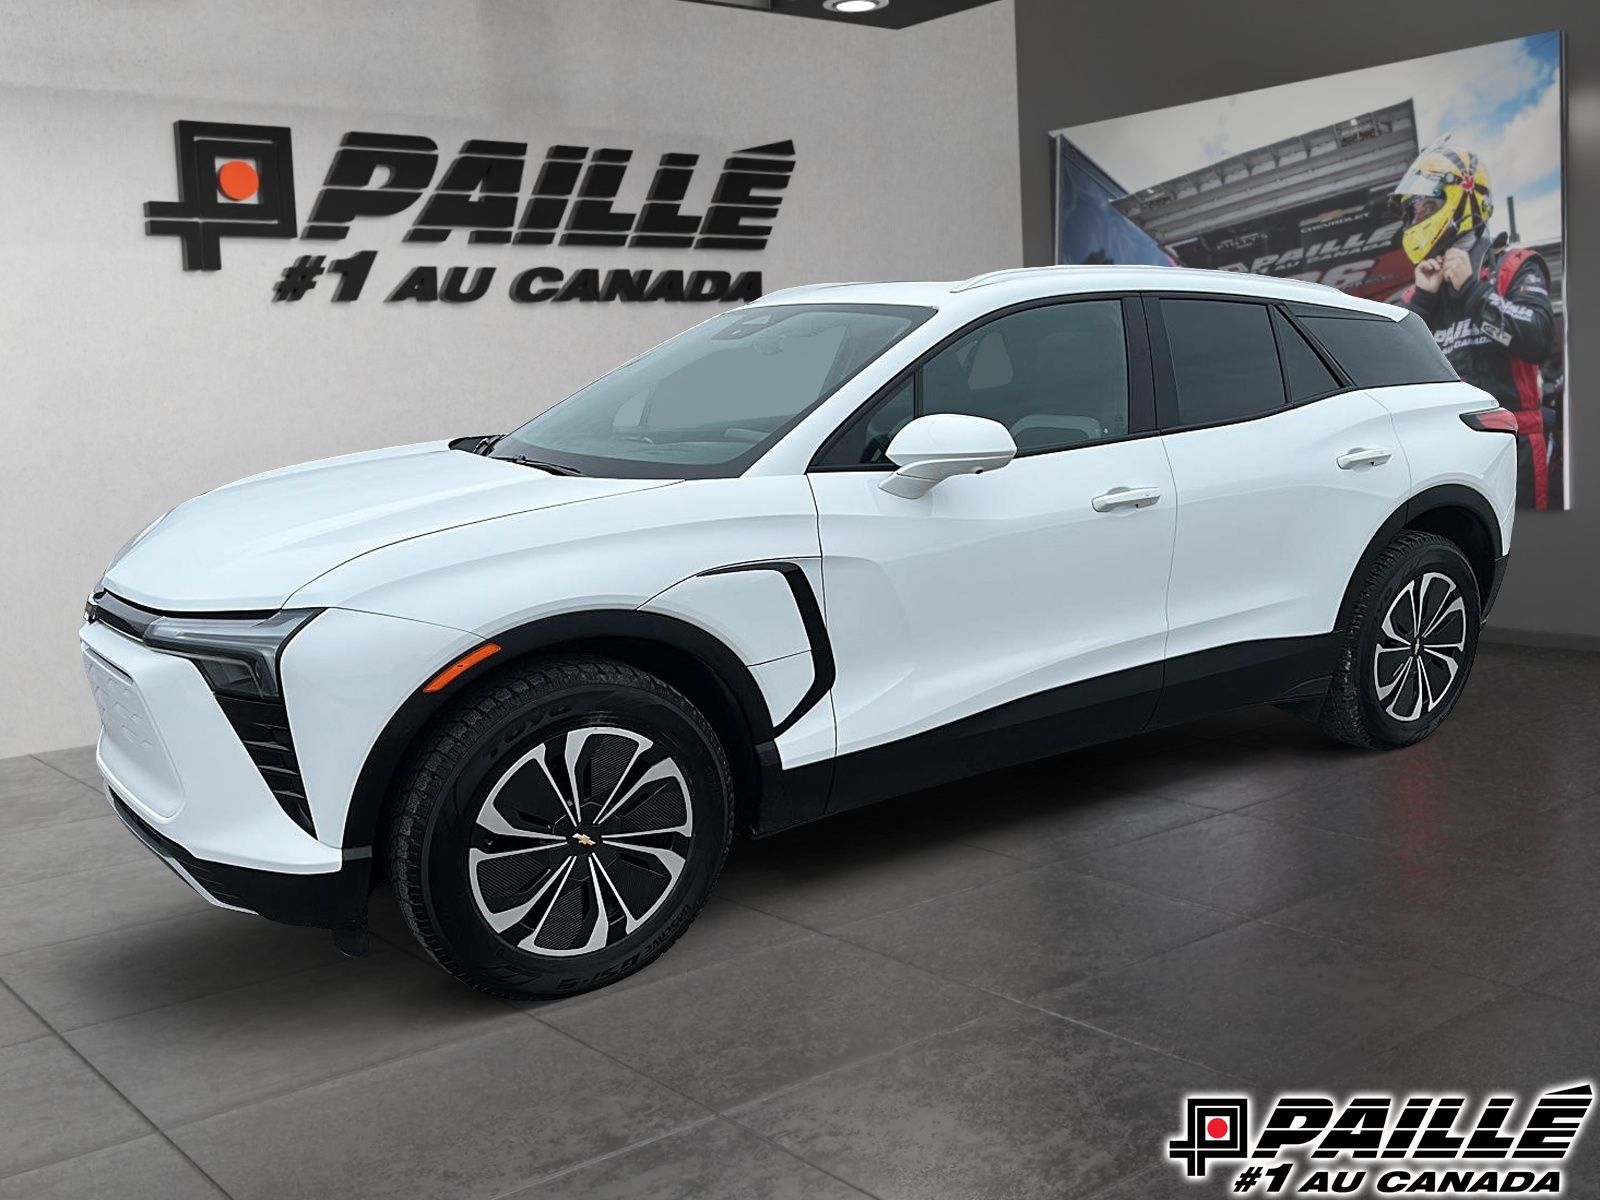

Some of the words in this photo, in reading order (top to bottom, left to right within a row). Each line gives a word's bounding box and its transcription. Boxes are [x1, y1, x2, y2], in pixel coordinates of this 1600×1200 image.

[301, 131, 795, 250] PAILLÉ
[272, 249, 378, 303] #1
[384, 266, 496, 303] AU
[508, 266, 762, 304] CANADA
